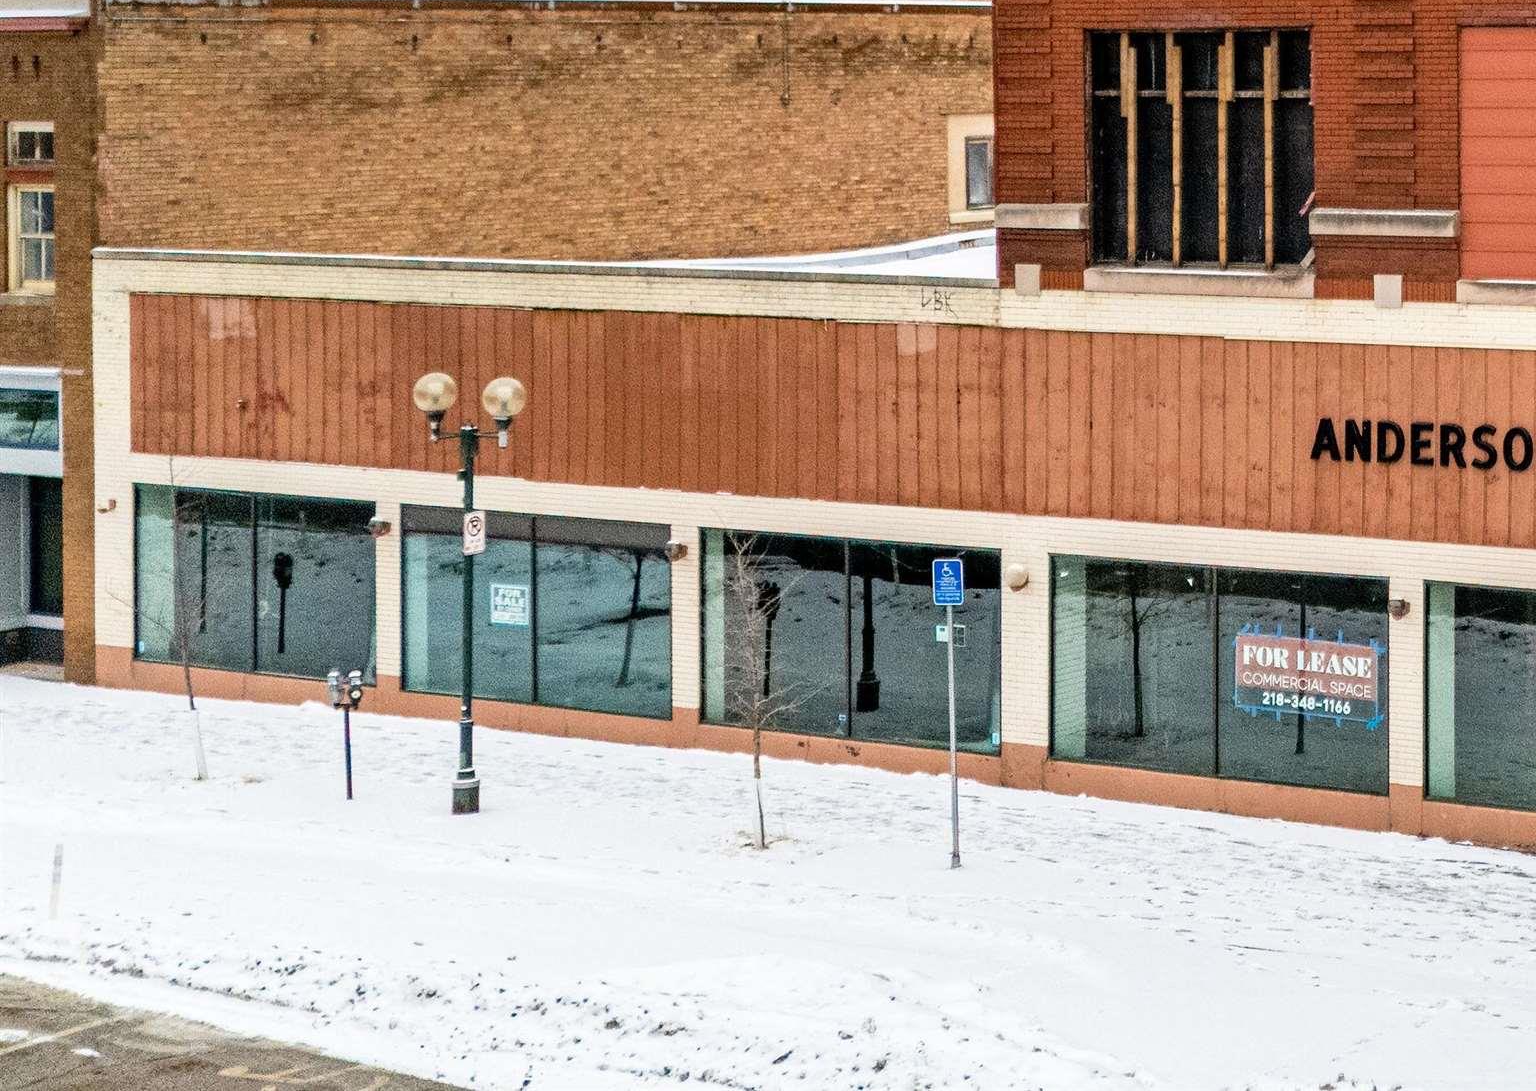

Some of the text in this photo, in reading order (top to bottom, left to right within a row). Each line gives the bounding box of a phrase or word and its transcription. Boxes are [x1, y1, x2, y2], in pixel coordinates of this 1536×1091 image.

[1243, 645, 1372, 678] FOR LEASE
[1242, 671, 1372, 699] COMMERCIAL SPACE
[1262, 692, 1351, 715] 218-348-1166
